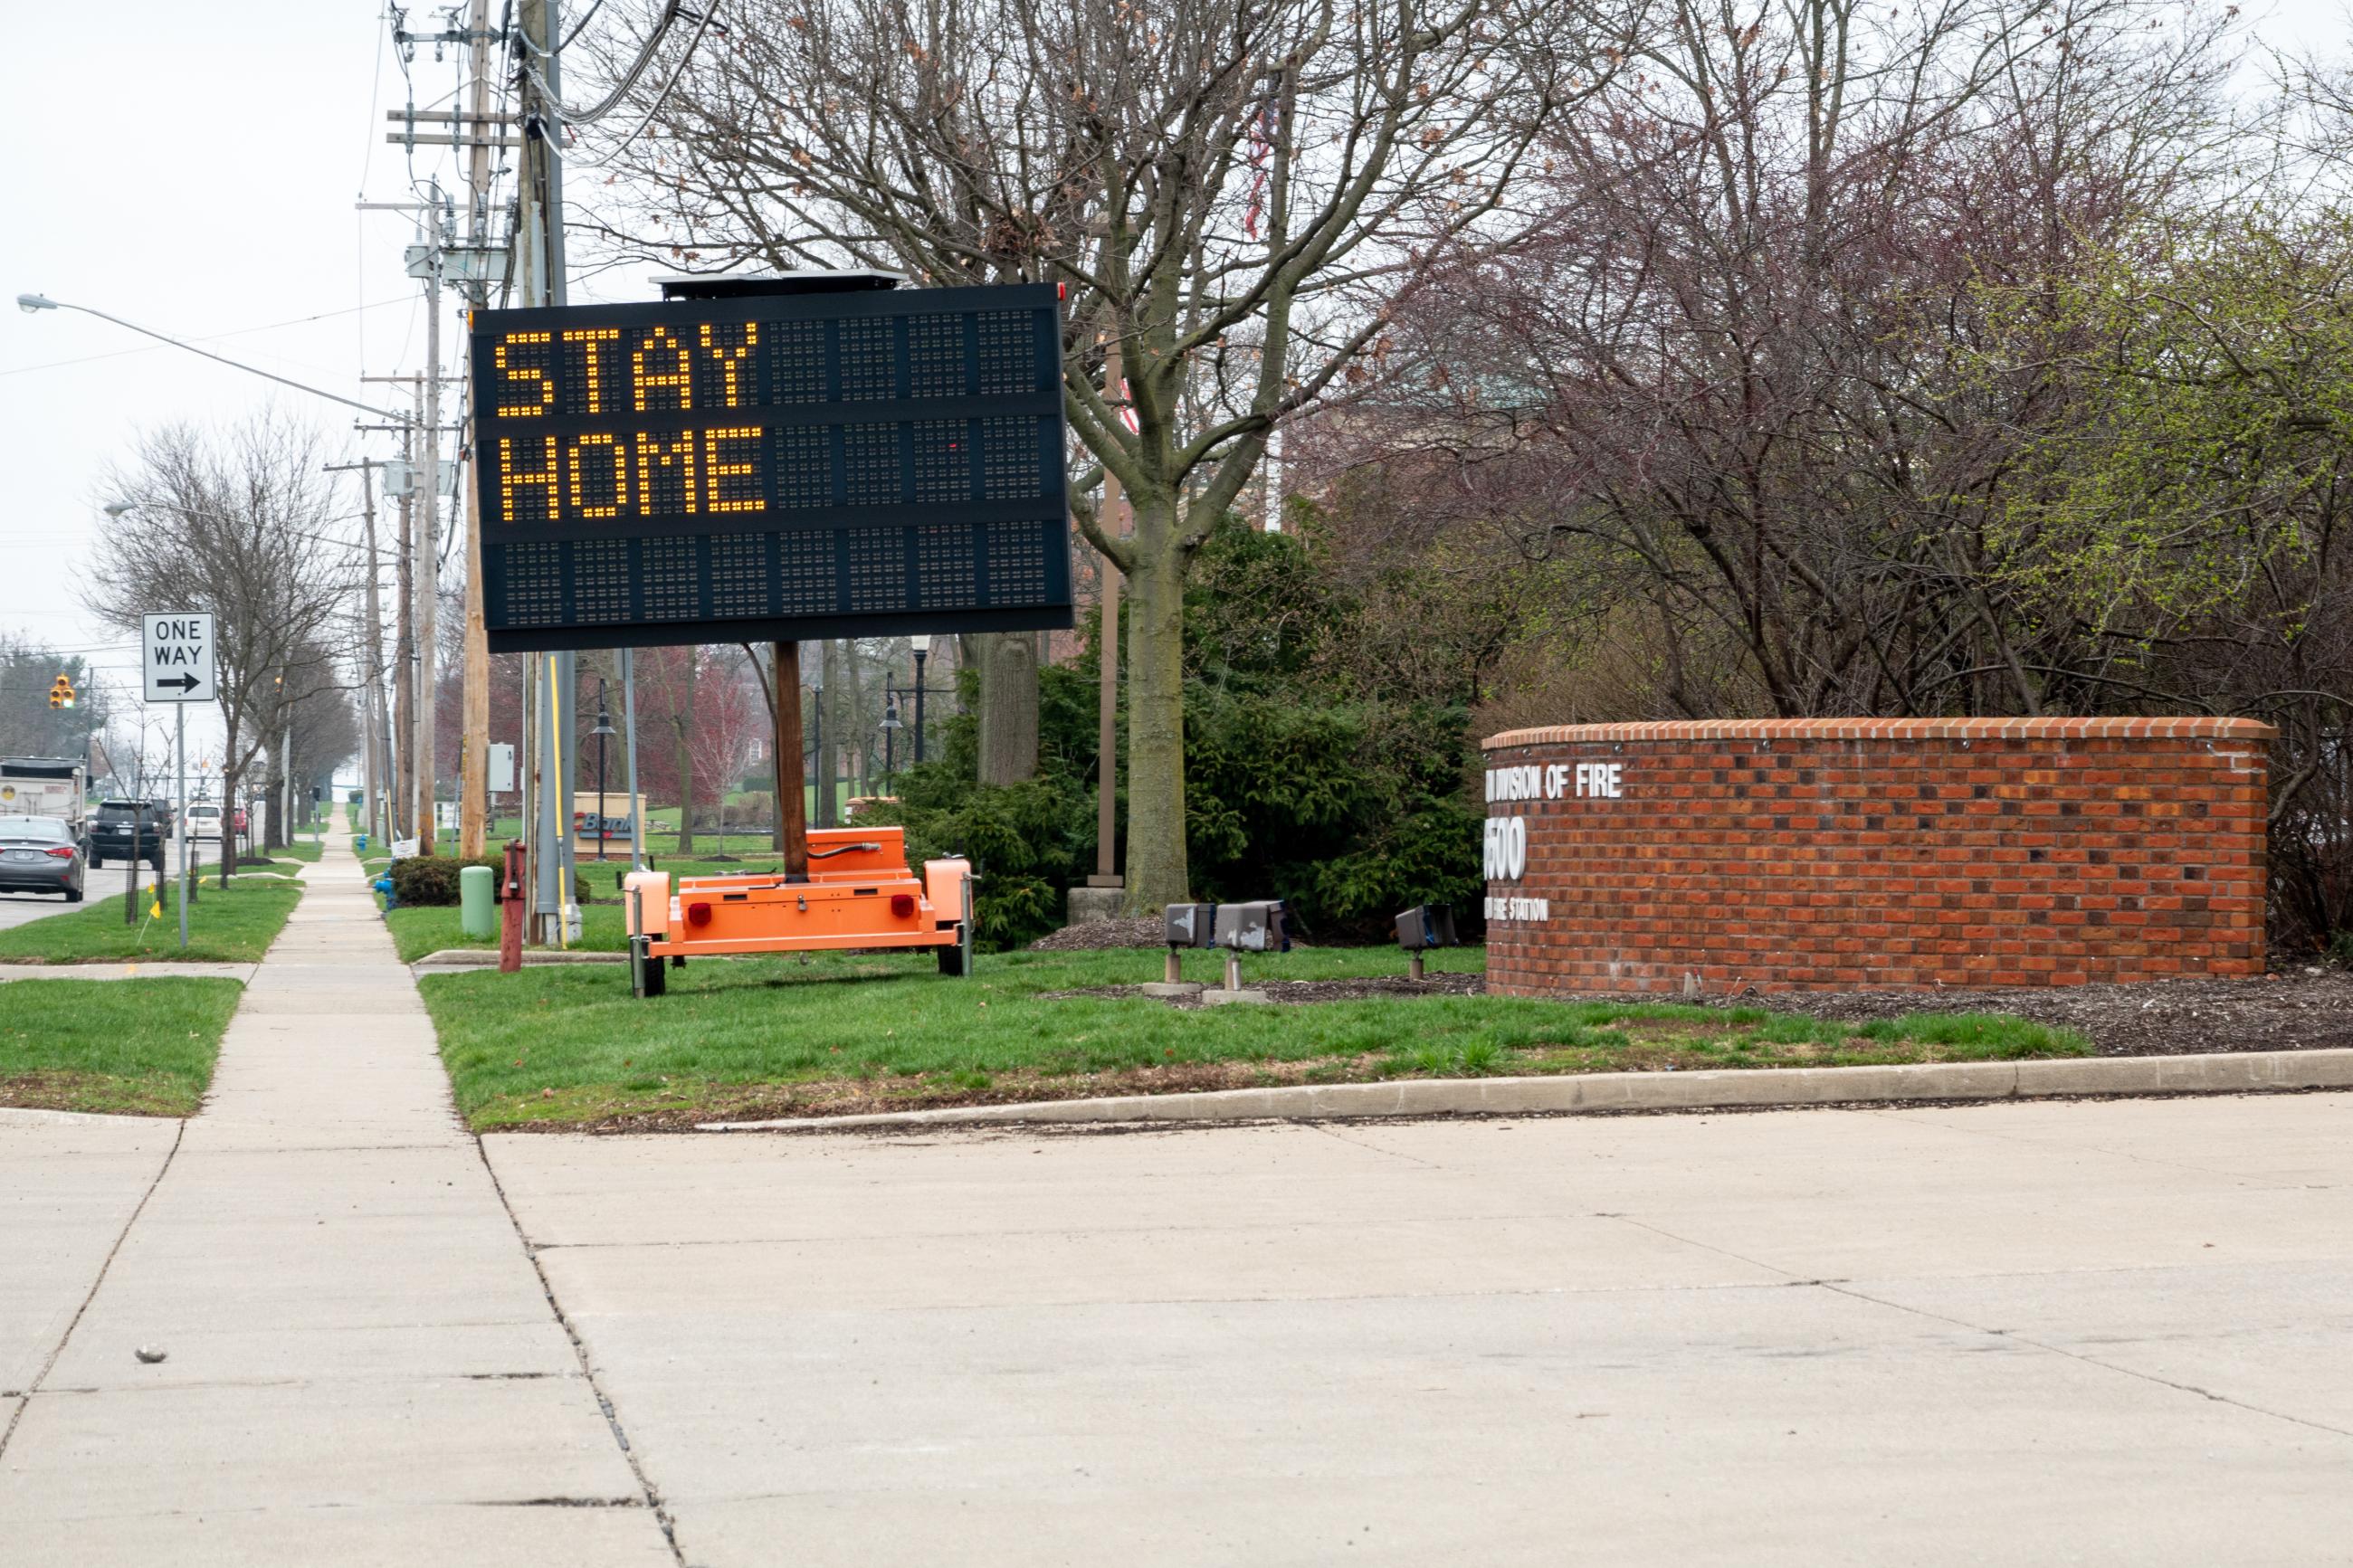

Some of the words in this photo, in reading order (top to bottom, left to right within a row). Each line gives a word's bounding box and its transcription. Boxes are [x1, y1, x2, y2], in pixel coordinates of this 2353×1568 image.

[496, 322, 757, 417] STAY
[500, 426, 766, 521] HOME
[156, 620, 202, 641] ONE
[154, 645, 203, 666] WAY
[1546, 764, 1569, 800] OF
[1577, 763, 1623, 798] FIRE
